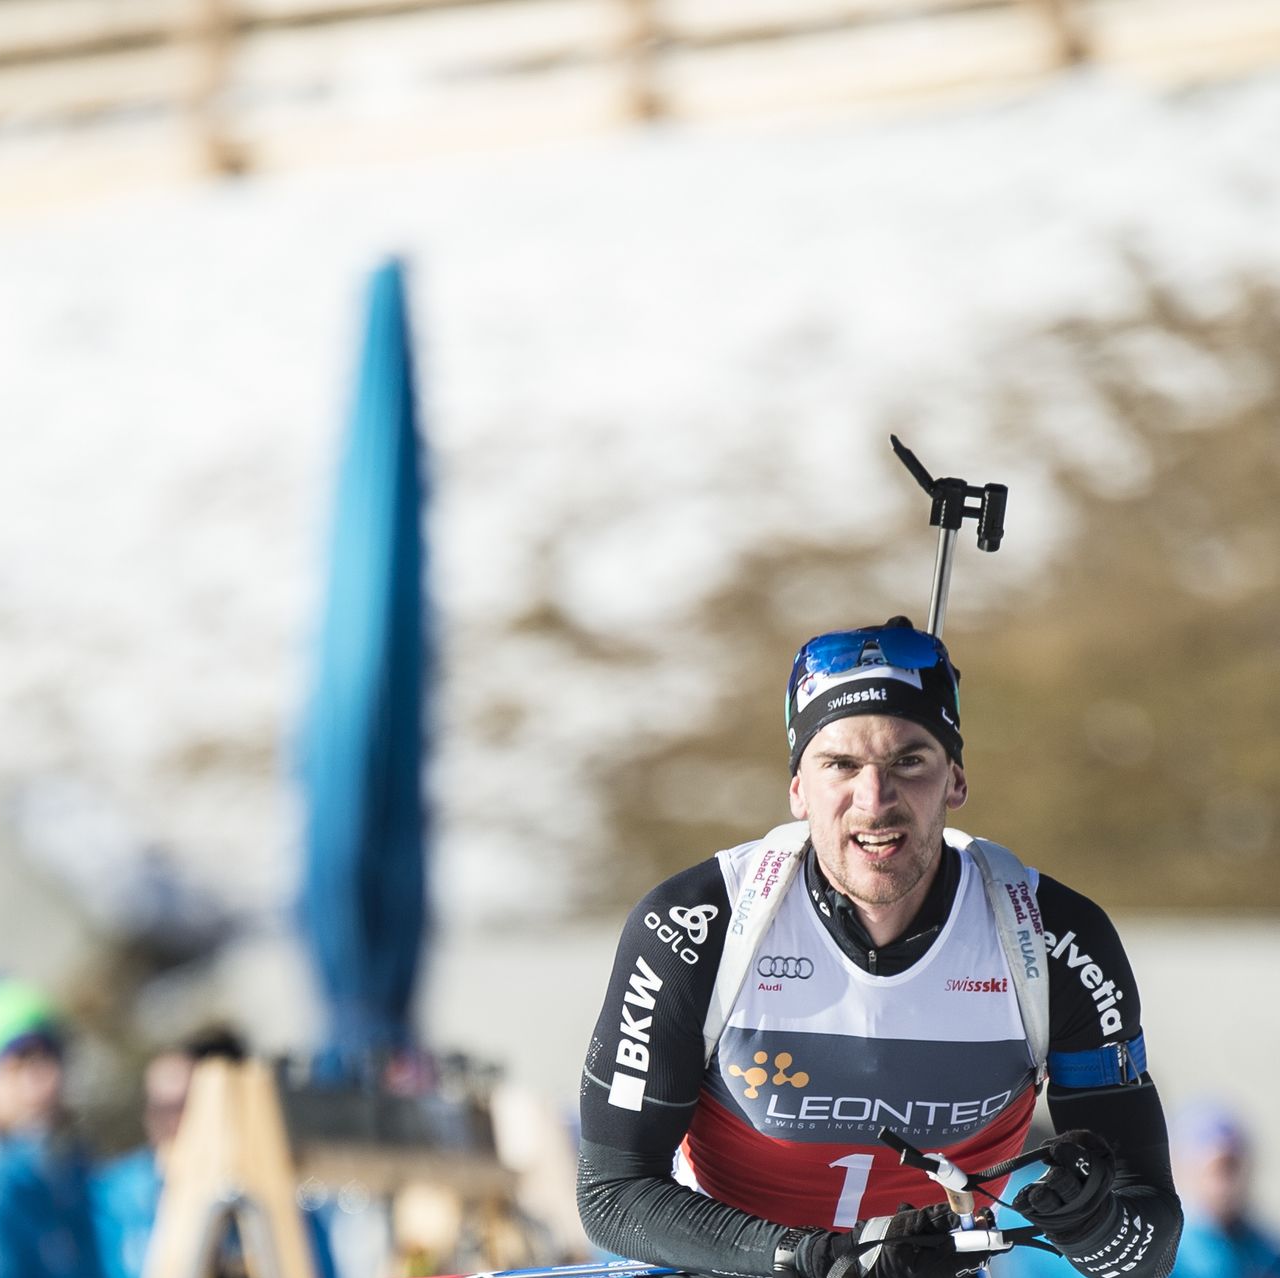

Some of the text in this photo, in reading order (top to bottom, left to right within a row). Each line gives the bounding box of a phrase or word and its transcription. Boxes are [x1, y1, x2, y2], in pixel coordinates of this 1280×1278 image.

[827, 688, 888, 712] swissski
[732, 888, 757, 936] RUAG
[1016, 880, 1045, 937] Together
[643, 911, 700, 965] odlo
[1016, 929, 1040, 981] RUAG
[757, 982, 783, 992] Audi
[944, 976, 1008, 993] swissski
[1042, 930, 1124, 1037] elvetia
[615, 954, 664, 1073] BKW
[765, 1117, 816, 1130] SWISS
[828, 1153, 875, 1228] 1
[1121, 1223, 1155, 1272] BKW
